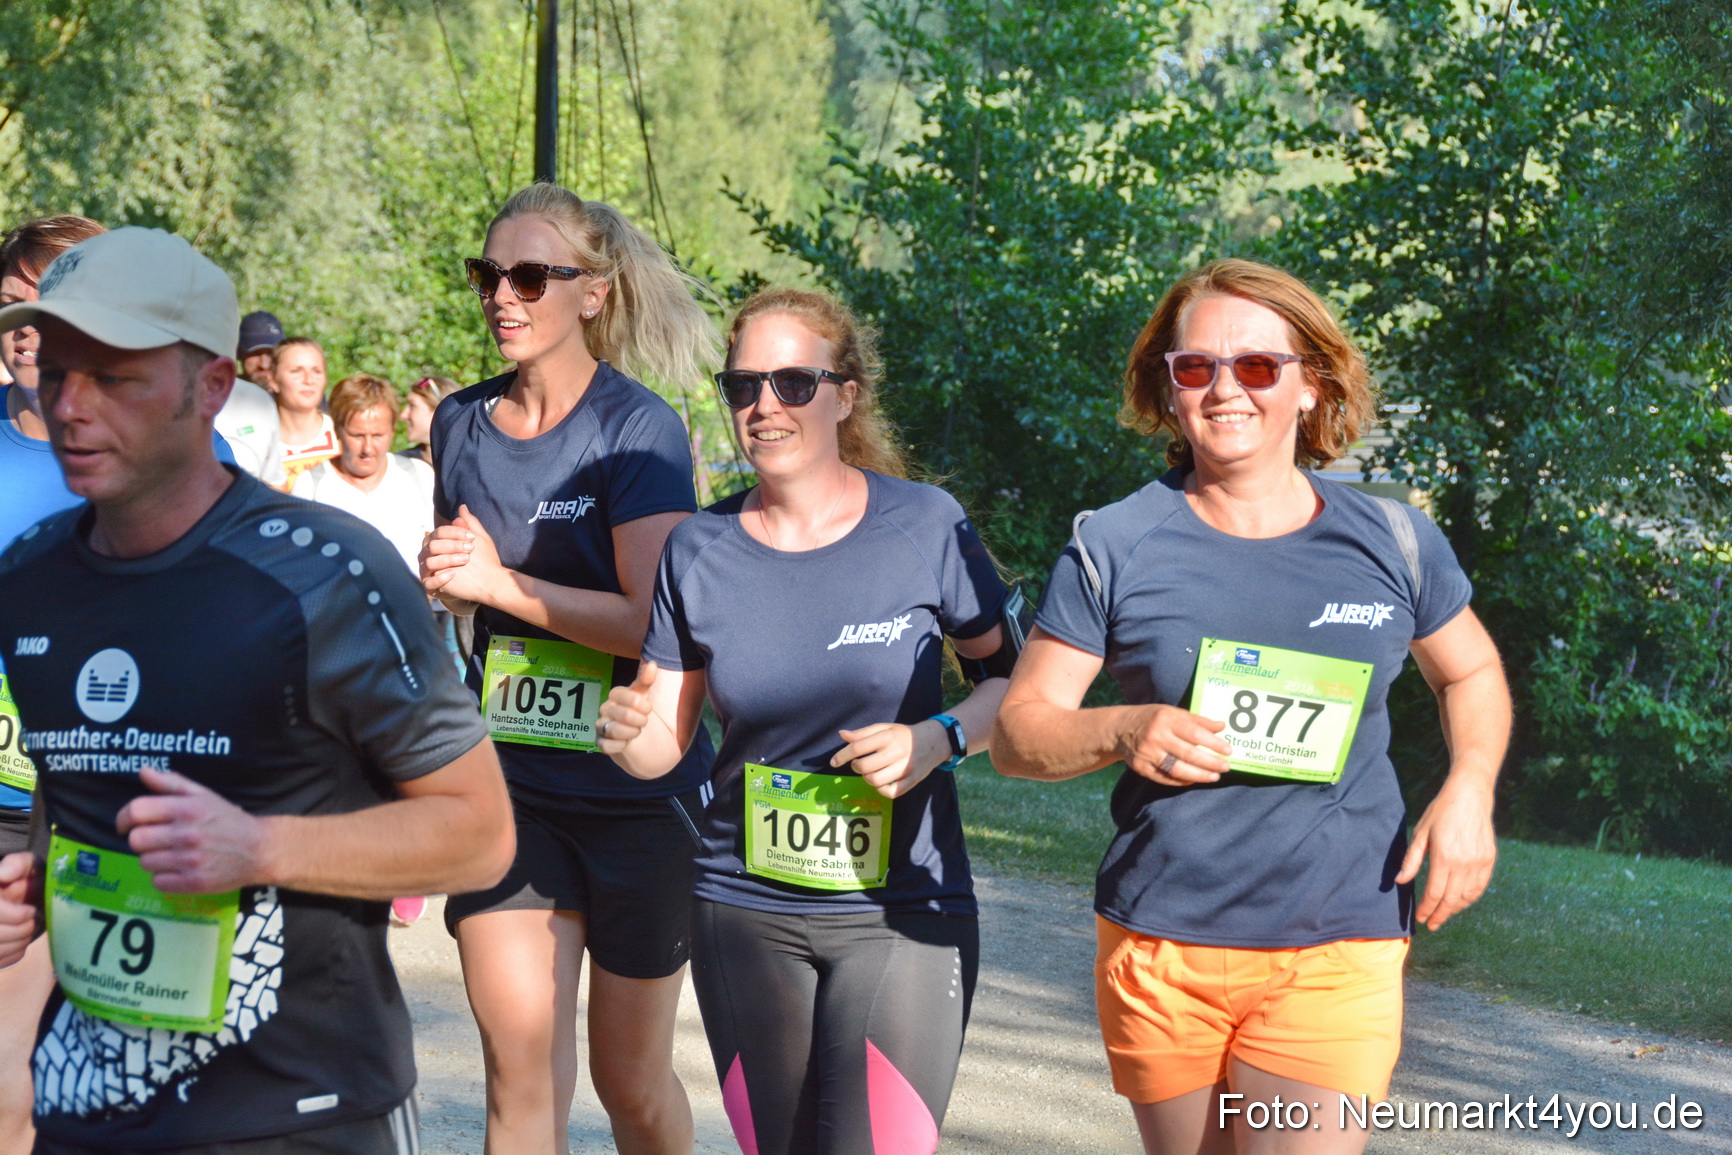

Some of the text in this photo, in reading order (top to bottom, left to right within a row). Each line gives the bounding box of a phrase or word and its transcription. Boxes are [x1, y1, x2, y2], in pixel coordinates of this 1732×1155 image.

[528, 500, 578, 524] JURA
[1309, 603, 1375, 628] JURA
[827, 621, 894, 650] JURA
[1222, 660, 1281, 680] firmenlauf
[497, 674, 585, 720] 1051
[491, 712, 590, 732] Hantzsche Stephanie
[1228, 690, 1326, 744] 877
[496, 724, 579, 740] Lebenshilfe Neumarkt e.V.
[1224, 734, 1317, 759] Strobl Christian
[45, 754, 170, 772] SCHOTTERWERKE
[1268, 754, 1294, 766] GmbH
[763, 784, 811, 801] firmenlauf
[763, 809, 871, 858] 1046
[766, 848, 865, 869] Dietmayer Sabrina
[768, 860, 807, 875] Lebenshilfe
[808, 868, 846, 878] Neumarkt
[90, 908, 155, 976] 79
[64, 961, 189, 1001] Weißmüller Rainer
